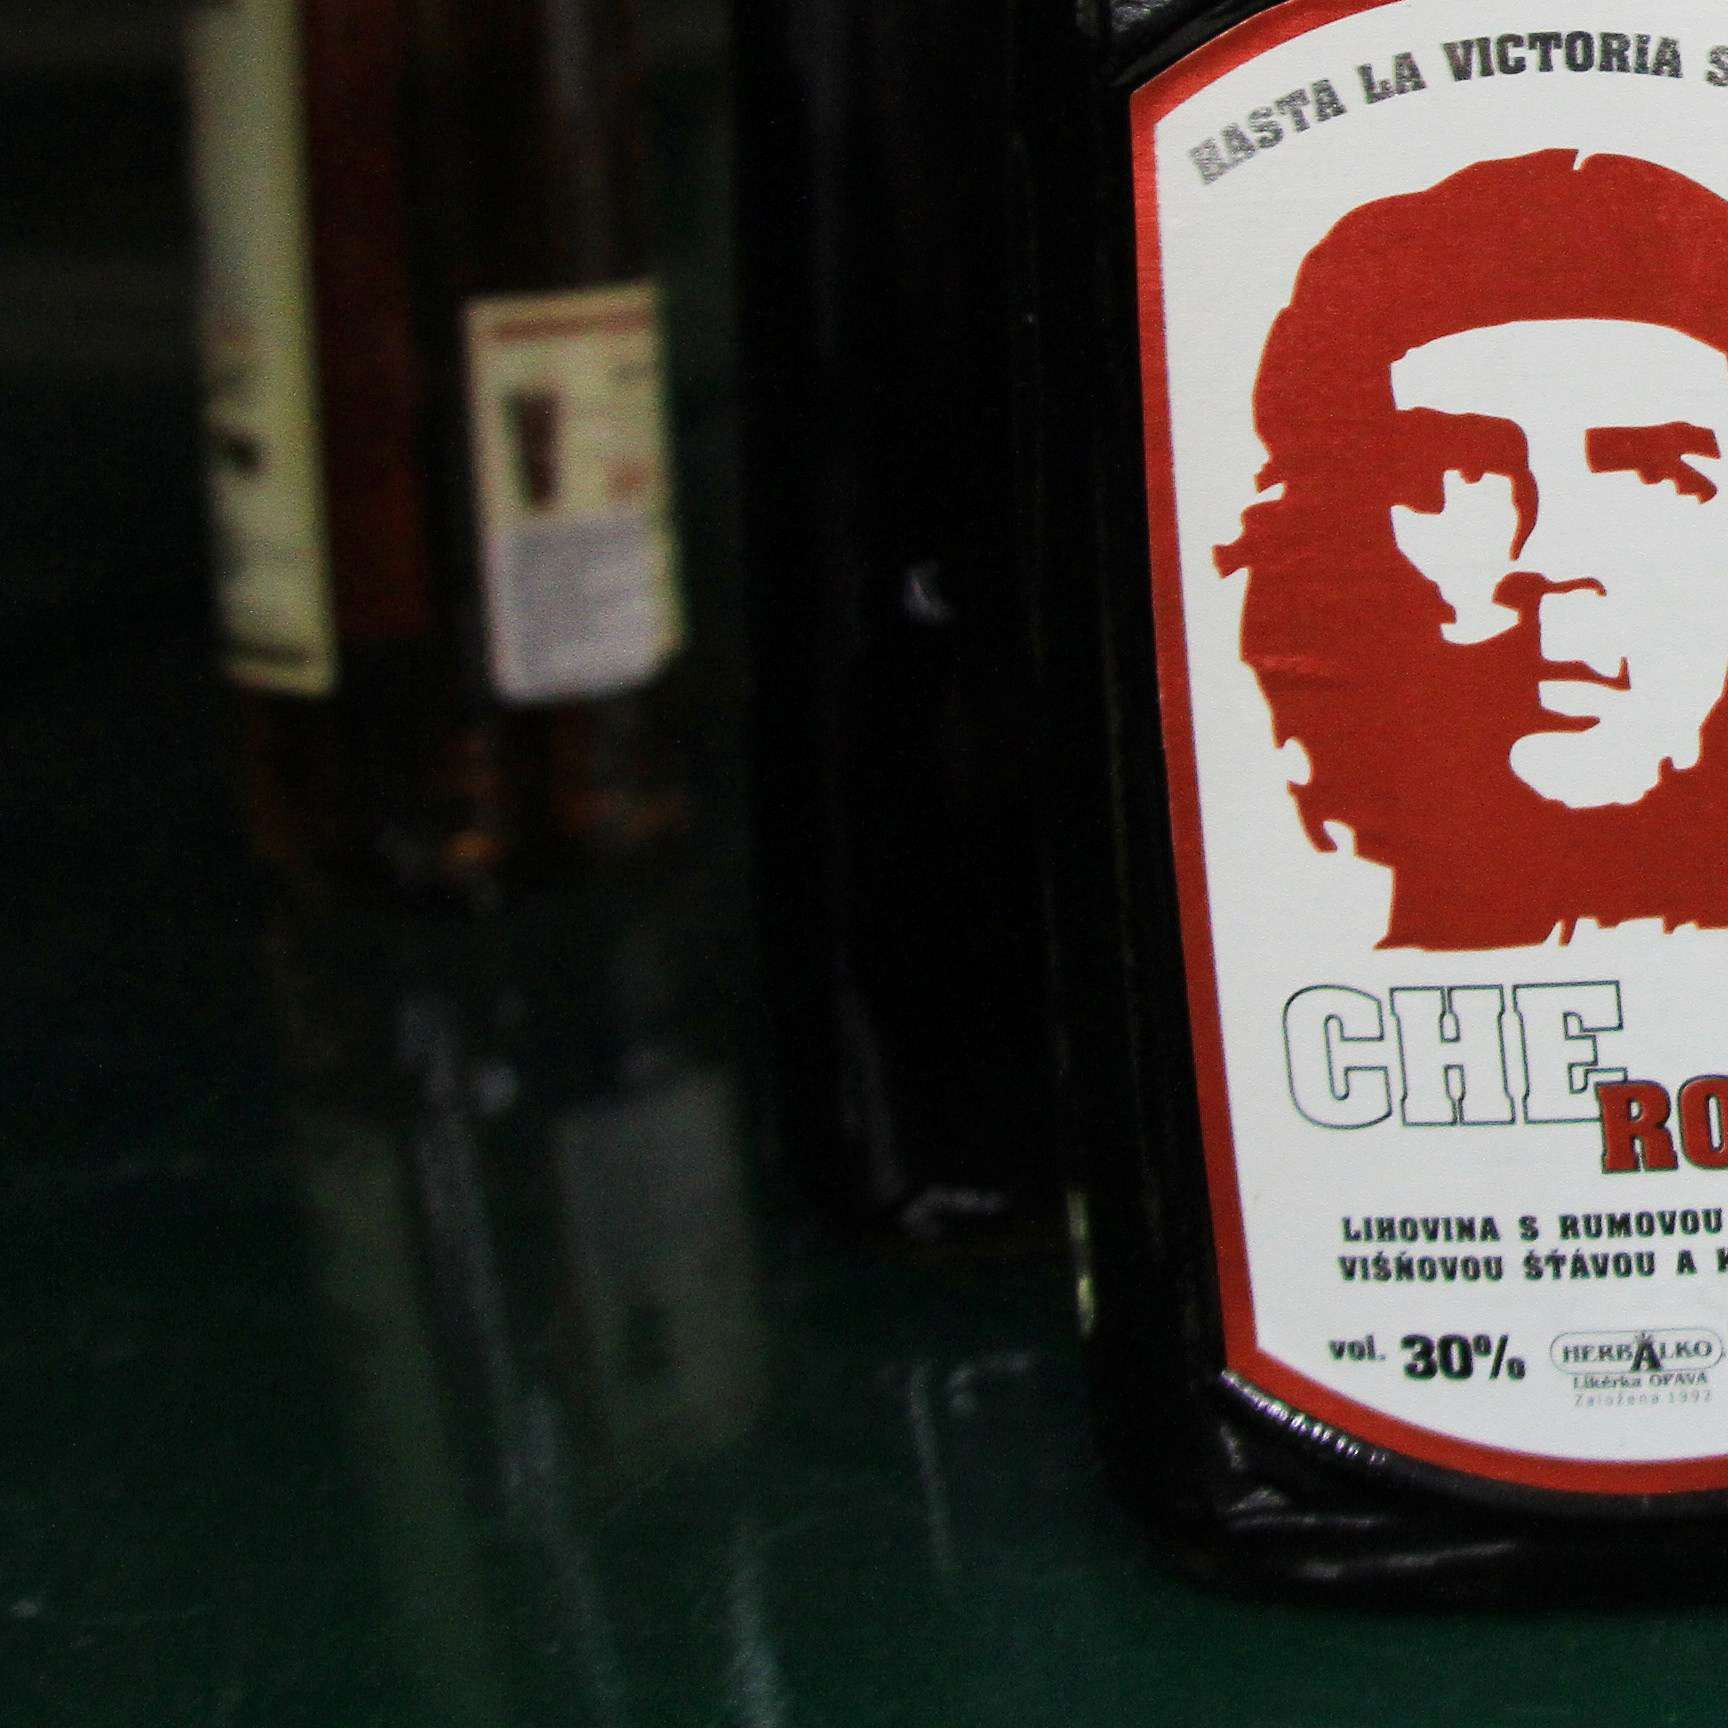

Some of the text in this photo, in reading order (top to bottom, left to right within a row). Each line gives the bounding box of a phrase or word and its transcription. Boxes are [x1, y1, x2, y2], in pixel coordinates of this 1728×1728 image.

[1189, 78, 1347, 184] HASTA
[1357, 51, 1427, 104] LA
[1443, 30, 1683, 82] VICTORIA
[1282, 979, 1629, 1130] CHE
[1341, 1215, 1502, 1243] LIHOVINA
[1518, 1214, 1541, 1242] S
[1559, 1207, 1724, 1241] RUMOVOU
[1675, 1249, 1699, 1276] A
[1328, 1333, 1527, 1382] vol. 30%
